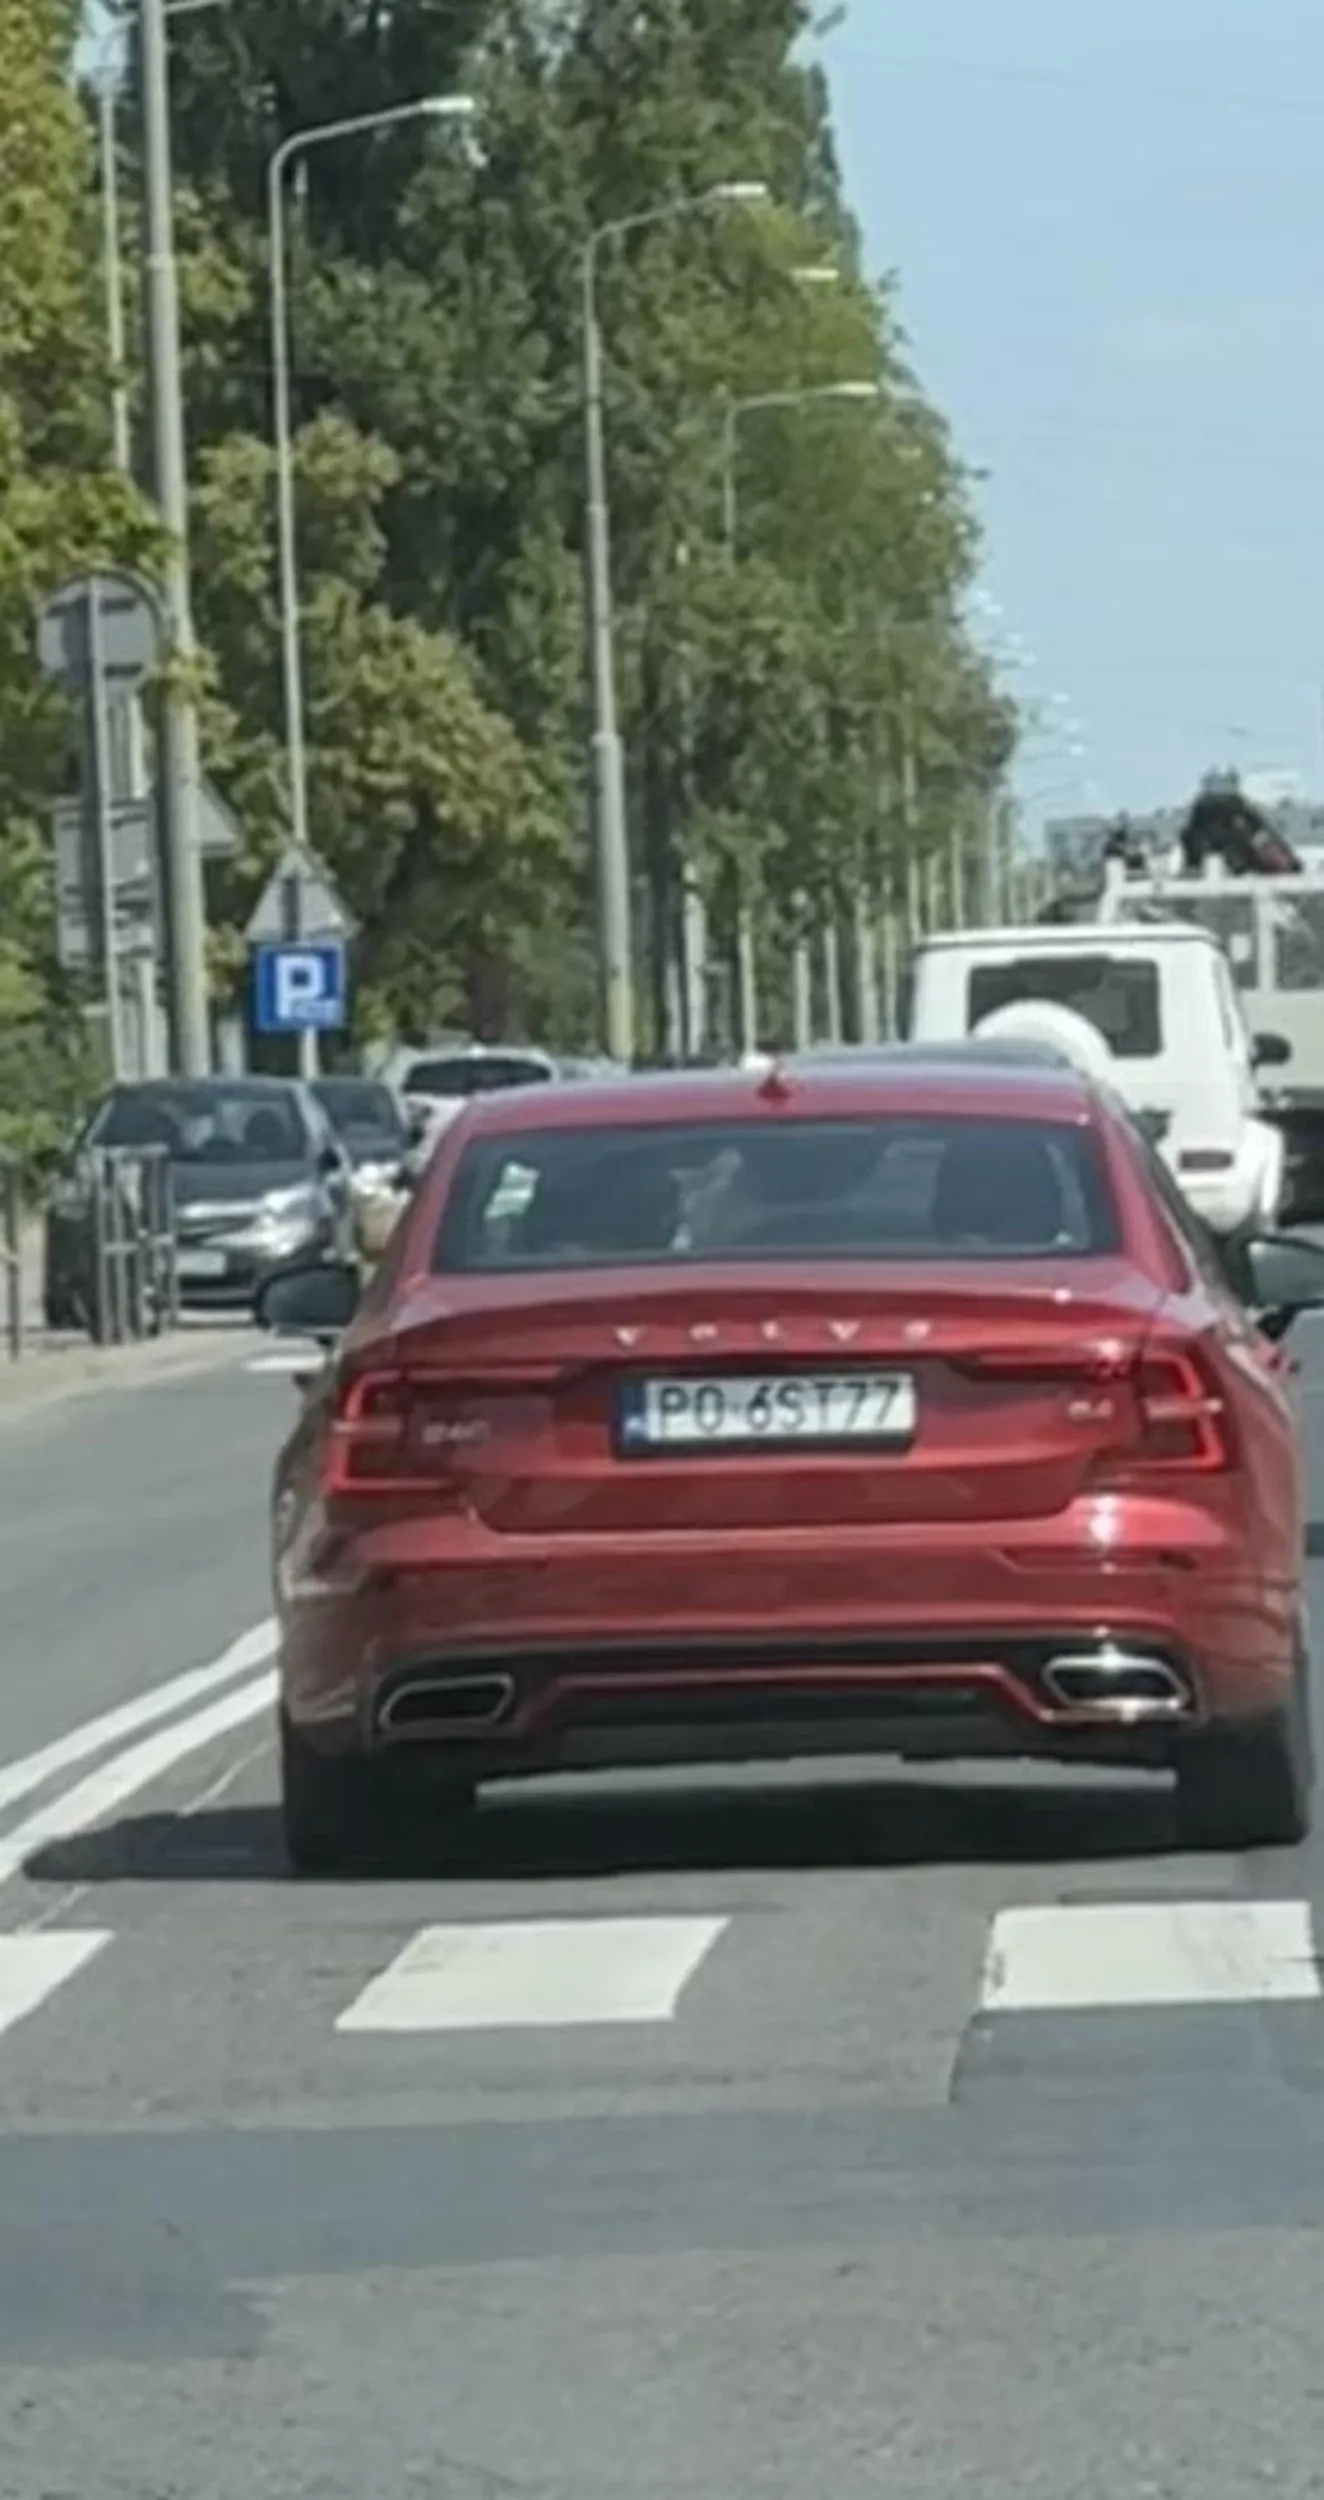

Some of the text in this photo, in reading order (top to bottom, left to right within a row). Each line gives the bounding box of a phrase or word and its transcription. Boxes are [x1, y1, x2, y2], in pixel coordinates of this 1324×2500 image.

[276, 955, 325, 1019] P
[659, 1384, 725, 1439] PO
[746, 1379, 901, 1432] 6ST77
